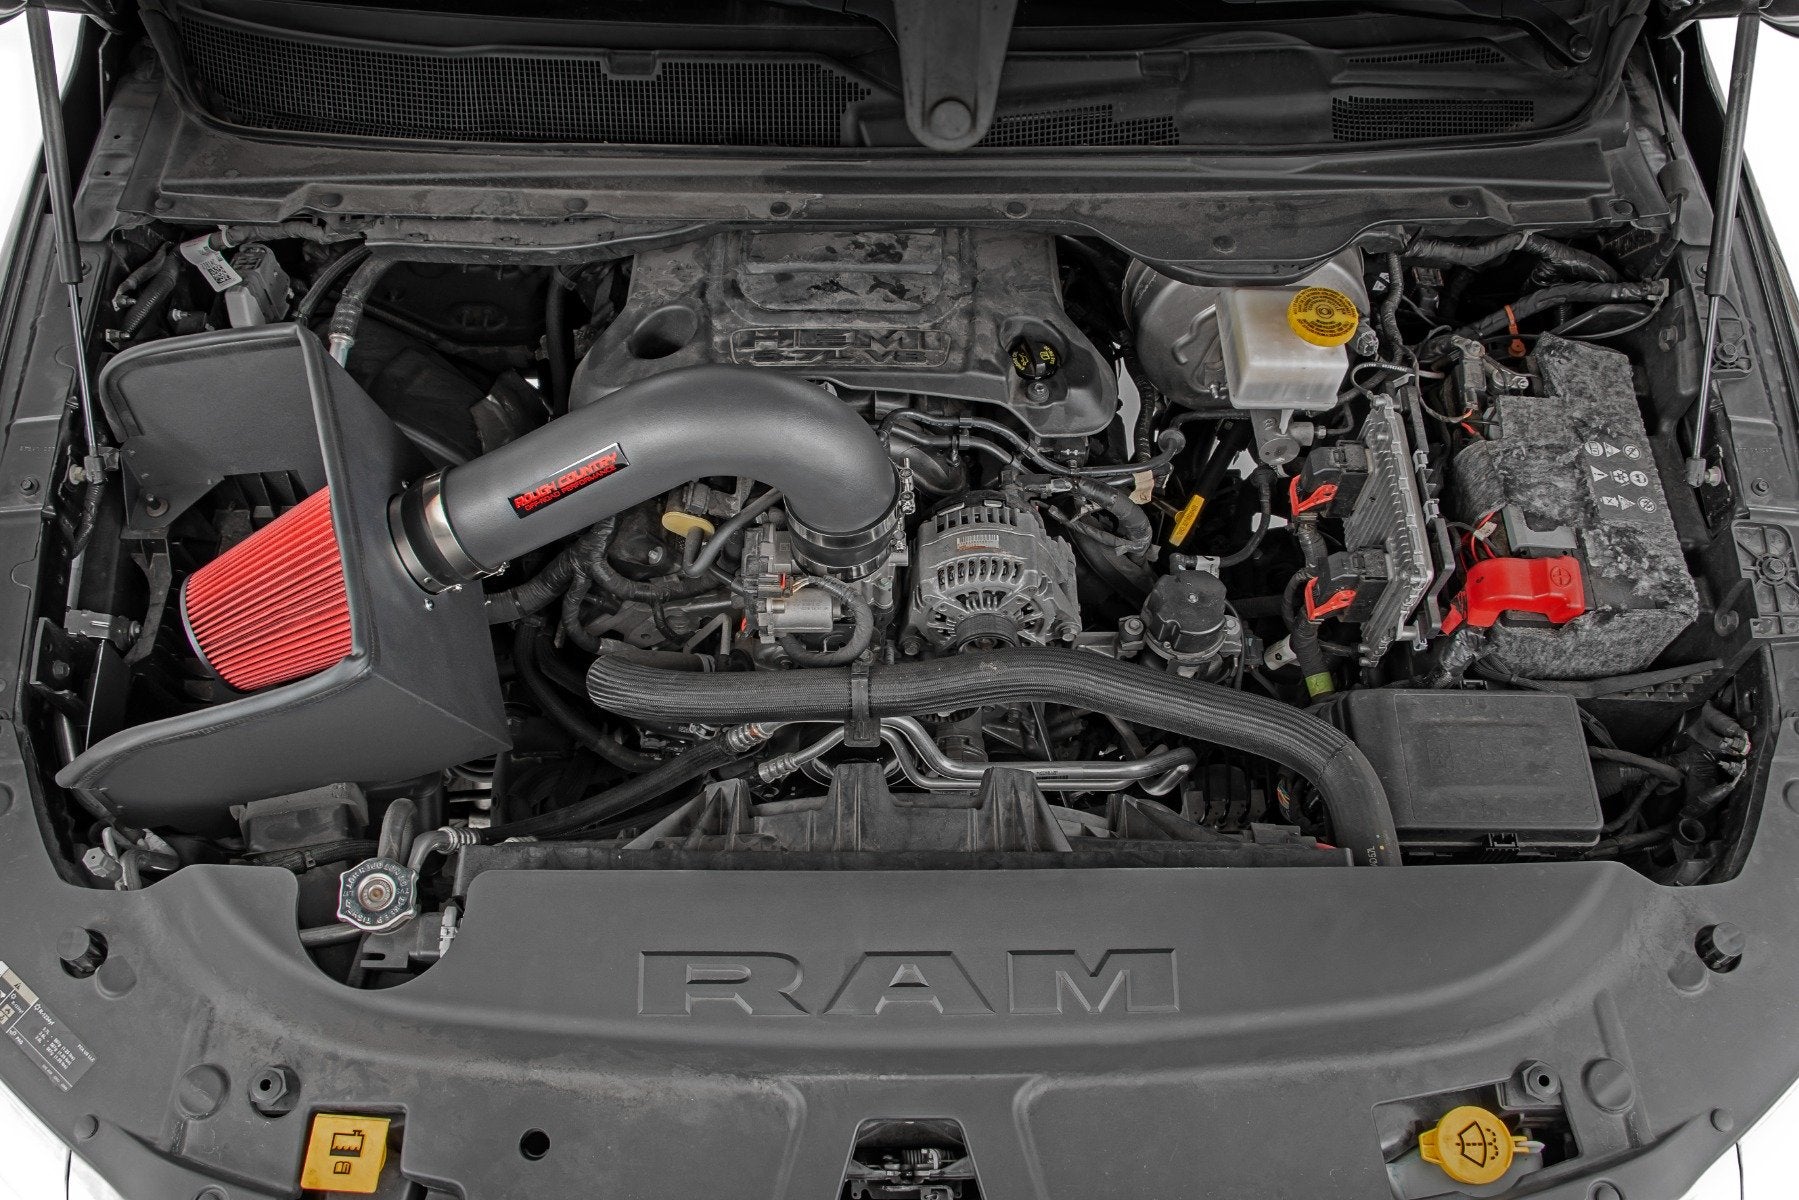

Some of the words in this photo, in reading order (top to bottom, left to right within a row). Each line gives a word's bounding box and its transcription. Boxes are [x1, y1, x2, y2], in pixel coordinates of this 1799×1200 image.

[513, 480, 558, 509] ROUGH
[558, 451, 618, 488] COUNTRY
[525, 489, 561, 511] OFF-ROAD
[562, 464, 617, 494] PERFORMANCE
[637, 947, 1181, 1016] RAM
